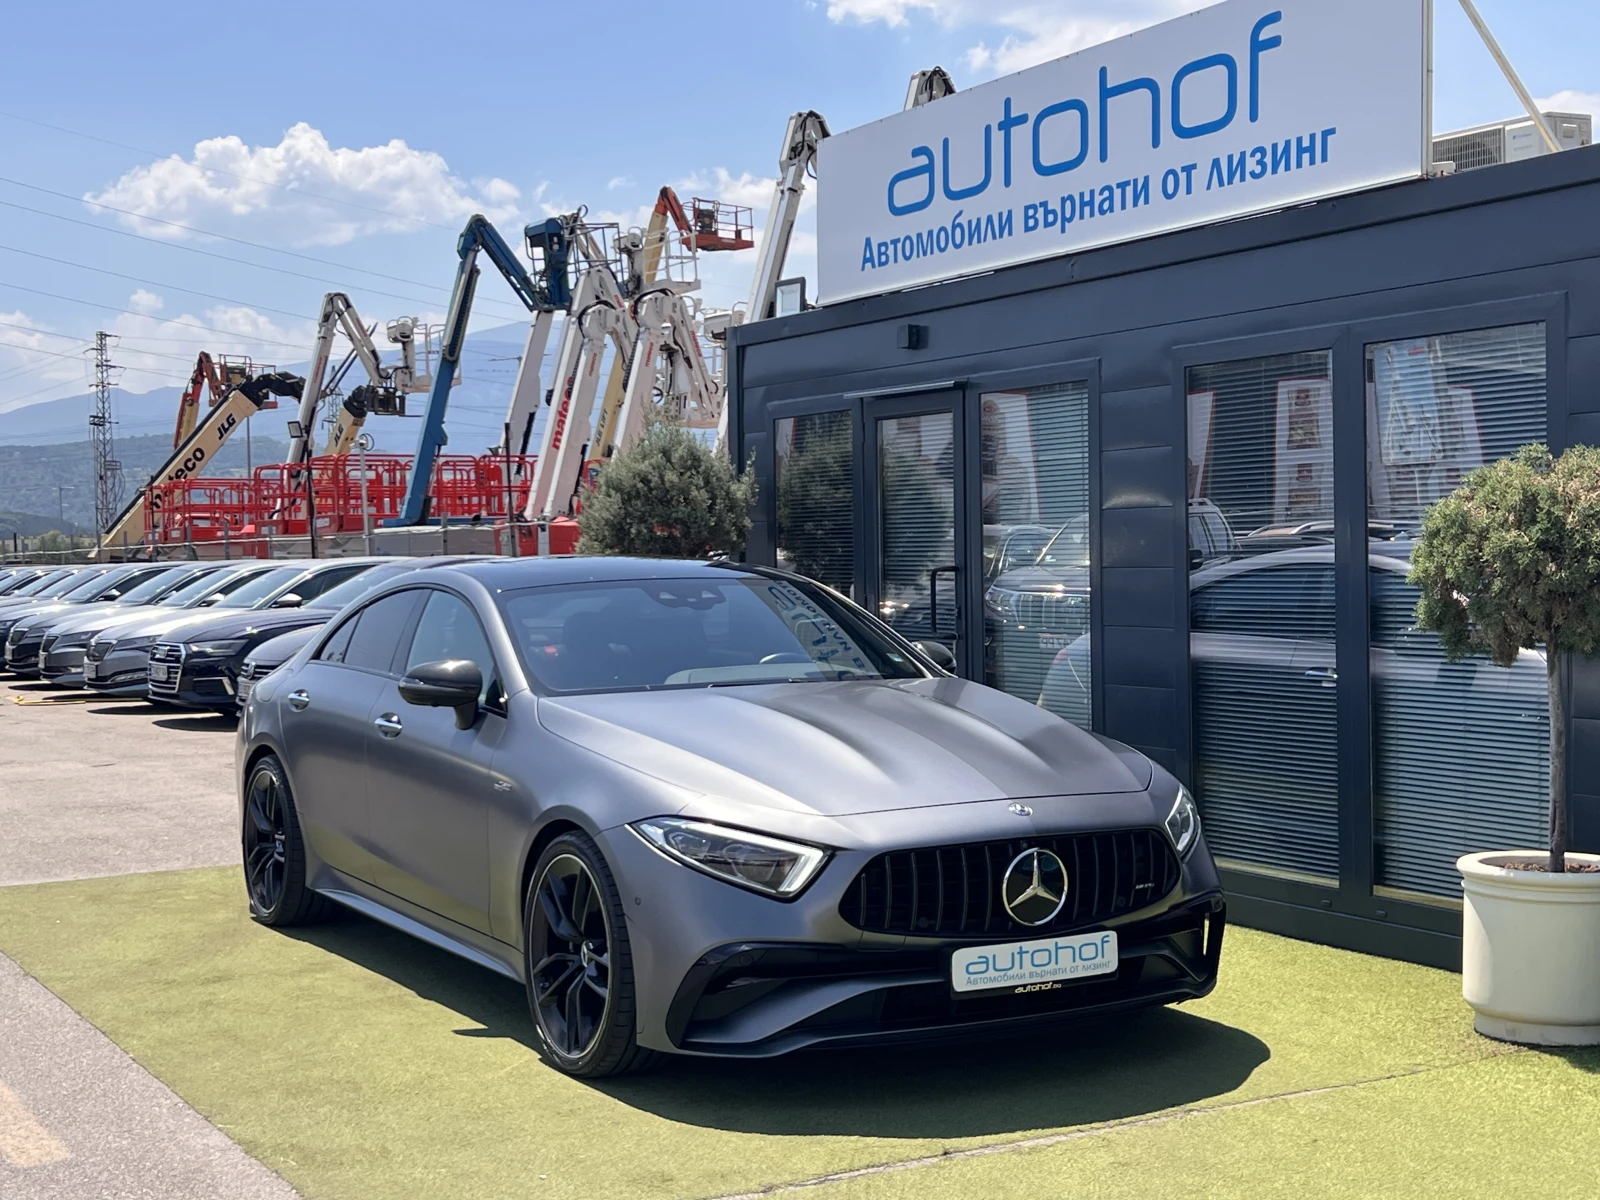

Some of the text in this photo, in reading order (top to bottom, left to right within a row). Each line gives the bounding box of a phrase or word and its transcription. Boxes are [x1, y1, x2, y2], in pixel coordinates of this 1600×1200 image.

[887, 10, 1283, 217] autohof
[860, 126, 1337, 272] Автомобили върнати от лизинг
[217, 413, 236, 440] JLG
[333, 423, 344, 447] JLG
[965, 934, 1110, 975] autohof
[966, 960, 1112, 986] Автомобили върнати от лизинг
